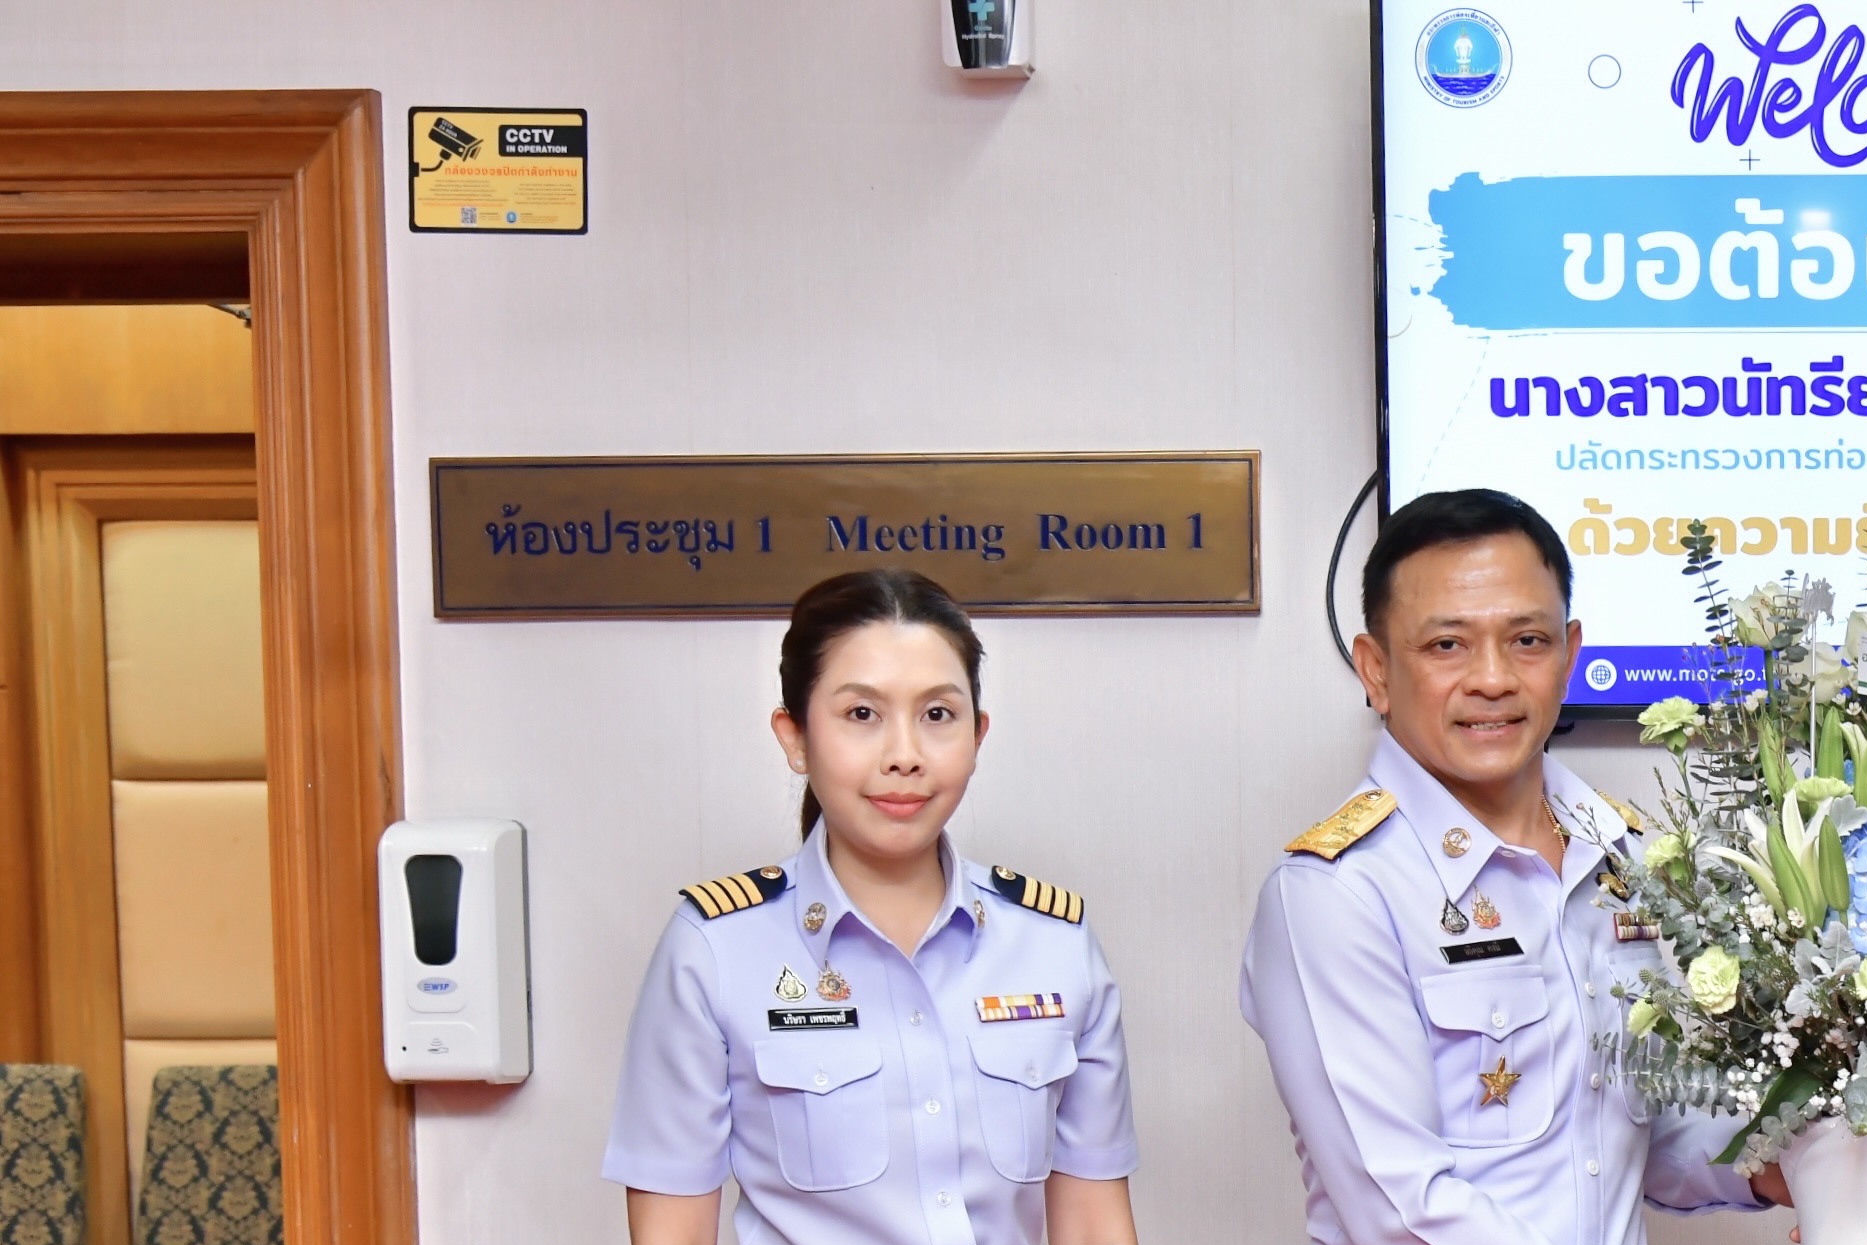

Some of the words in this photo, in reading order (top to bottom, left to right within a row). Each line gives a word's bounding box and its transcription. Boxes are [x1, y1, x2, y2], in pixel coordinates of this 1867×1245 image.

[505, 128, 554, 143] CCTV
[506, 145, 515, 153] IN
[518, 145, 568, 153] OPERATION
[485, 504, 735, 571] ห้องประชุม
[757, 515, 772, 552] 1
[825, 514, 1006, 562] Meeting
[1035, 513, 1167, 551] Room
[1187, 512, 1204, 550] 1
[1625, 665, 1767, 686] www.mot.go.t
